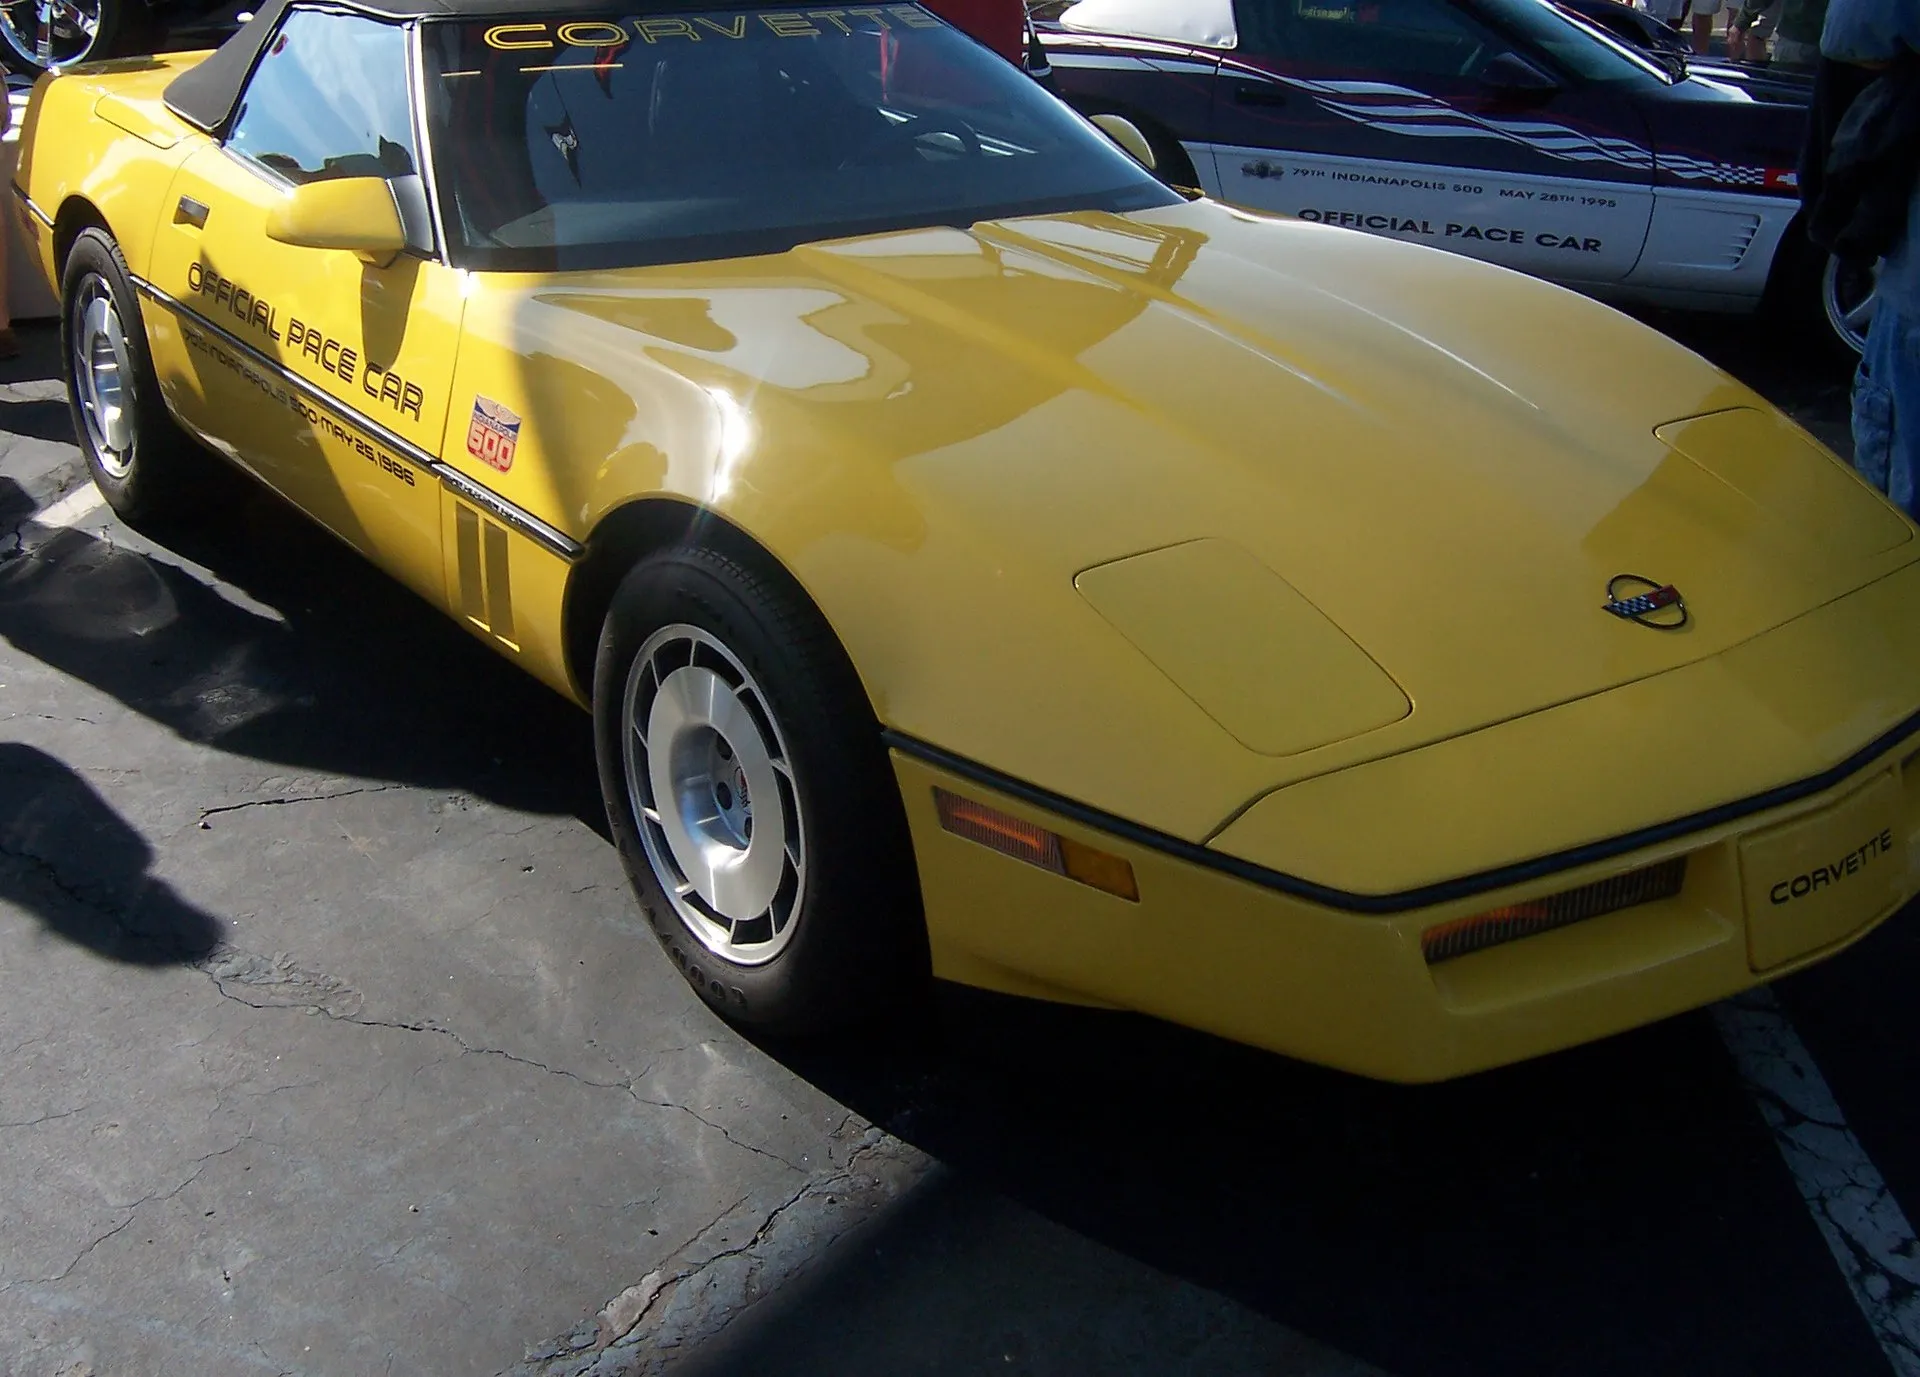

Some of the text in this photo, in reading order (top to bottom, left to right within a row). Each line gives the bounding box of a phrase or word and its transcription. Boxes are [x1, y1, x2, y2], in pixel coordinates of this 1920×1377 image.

[484, 7, 940, 50] CORVETTE
[1292, 167, 1617, 208] 79TH INDIANAPOLIS 500 MAY 28TH 1995
[1298, 208, 1602, 252] OFFICIAL PACE CAR
[187, 261, 424, 422] OFFICIAL PACE CAR
[289, 393, 318, 425] 500
[320, 415, 353, 448] MAY
[468, 420, 516, 470] 500
[1769, 827, 1892, 906] CORVETTE
